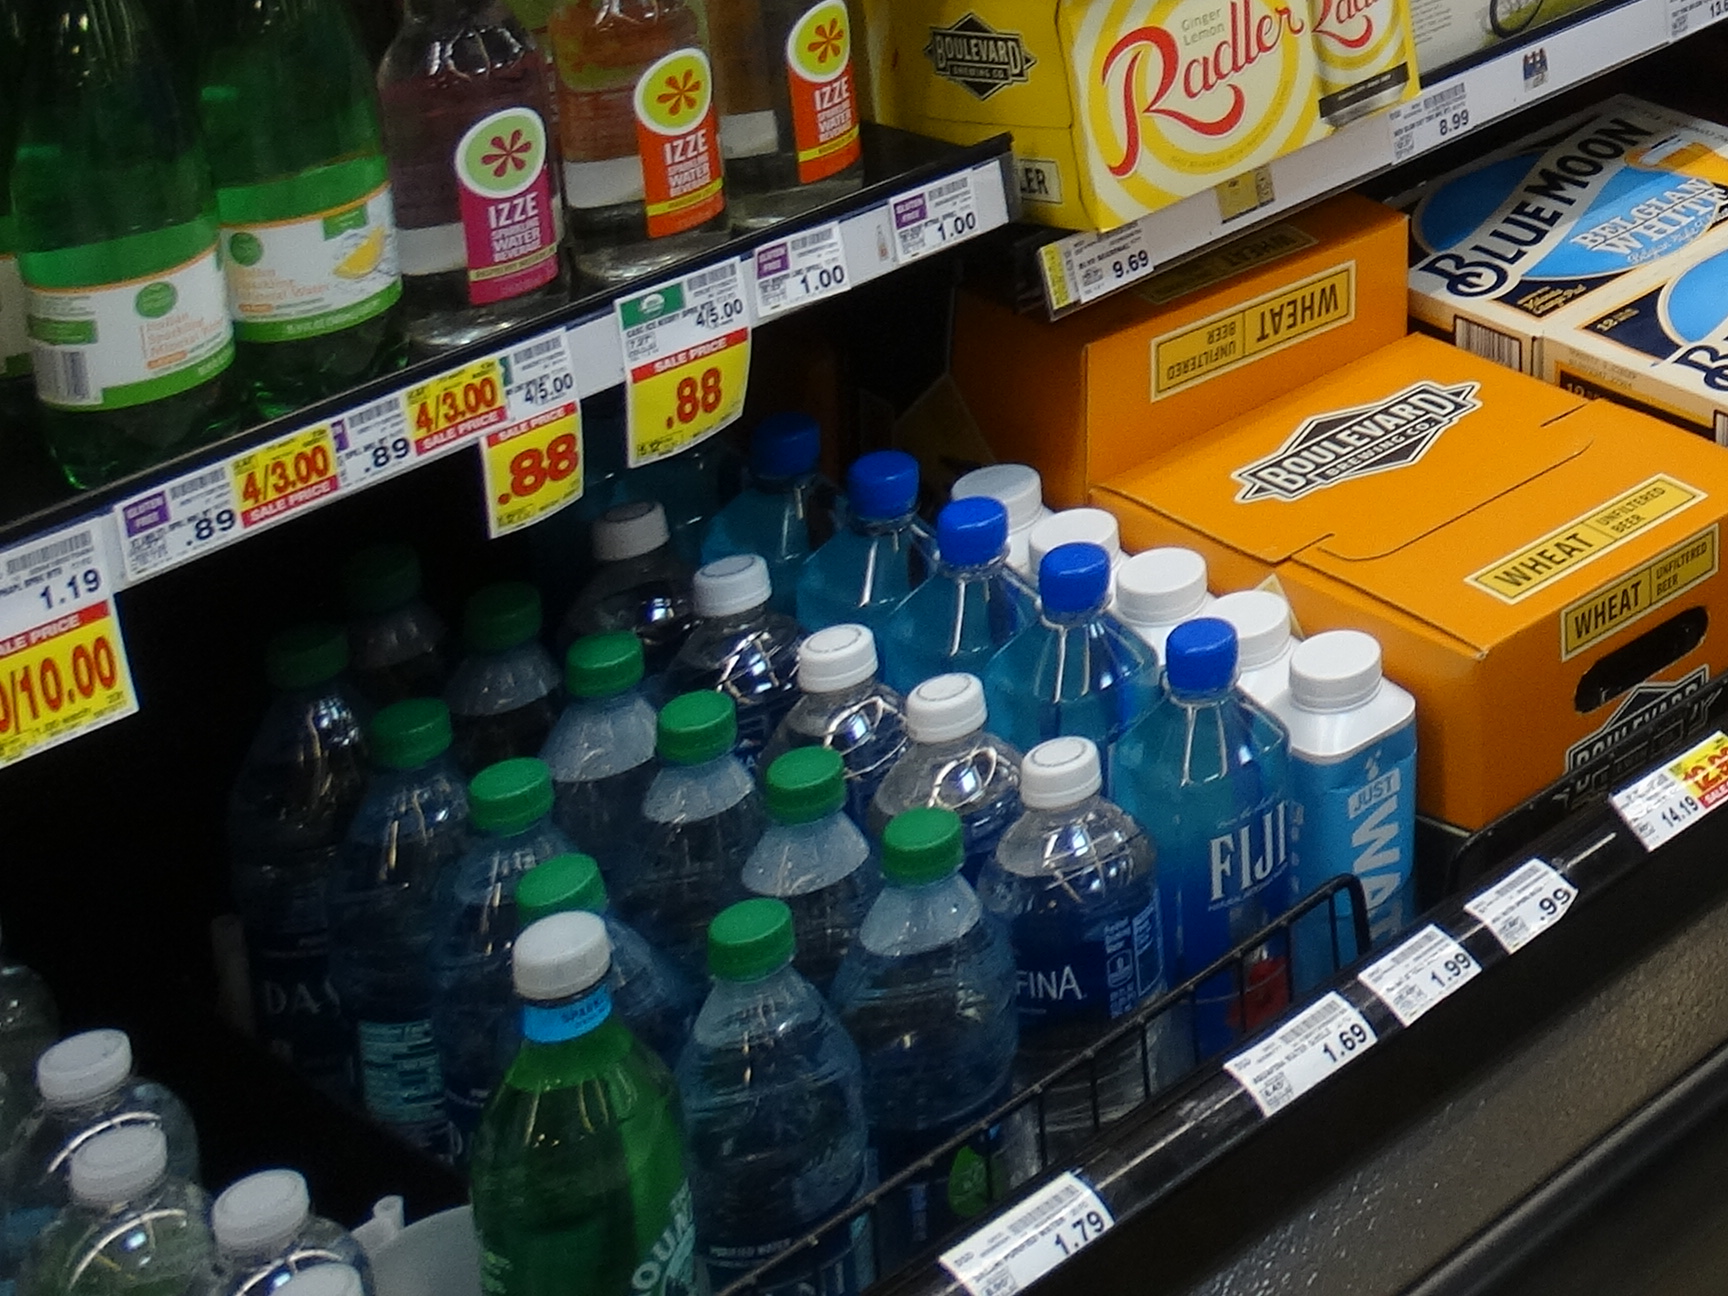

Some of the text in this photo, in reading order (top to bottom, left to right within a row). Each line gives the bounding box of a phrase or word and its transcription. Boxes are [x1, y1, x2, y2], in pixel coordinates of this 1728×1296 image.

[1437, 109, 1470, 136] 8.99
[485, 192, 540, 228] IZZE
[1112, 249, 1150, 279] 9.69
[1258, 387, 1457, 498] BOULEVARD
[241, 446, 331, 507] 4/3.00
[498, 436, 579, 509] .88
[1598, 483, 1665, 531] UNFILTERED
[1610, 514, 1645, 539] BEER
[186, 509, 237, 550] .89
[1500, 530, 1593, 592] WHEAT
[38, 569, 101, 610] 1.19
[1351, 776, 1399, 814] JUST
[1659, 793, 1698, 828] 14.19
[1209, 814, 1291, 901] FIJI
[1429, 952, 1473, 992] 1.99
[1053, 1212, 1107, 1259] 1.79
